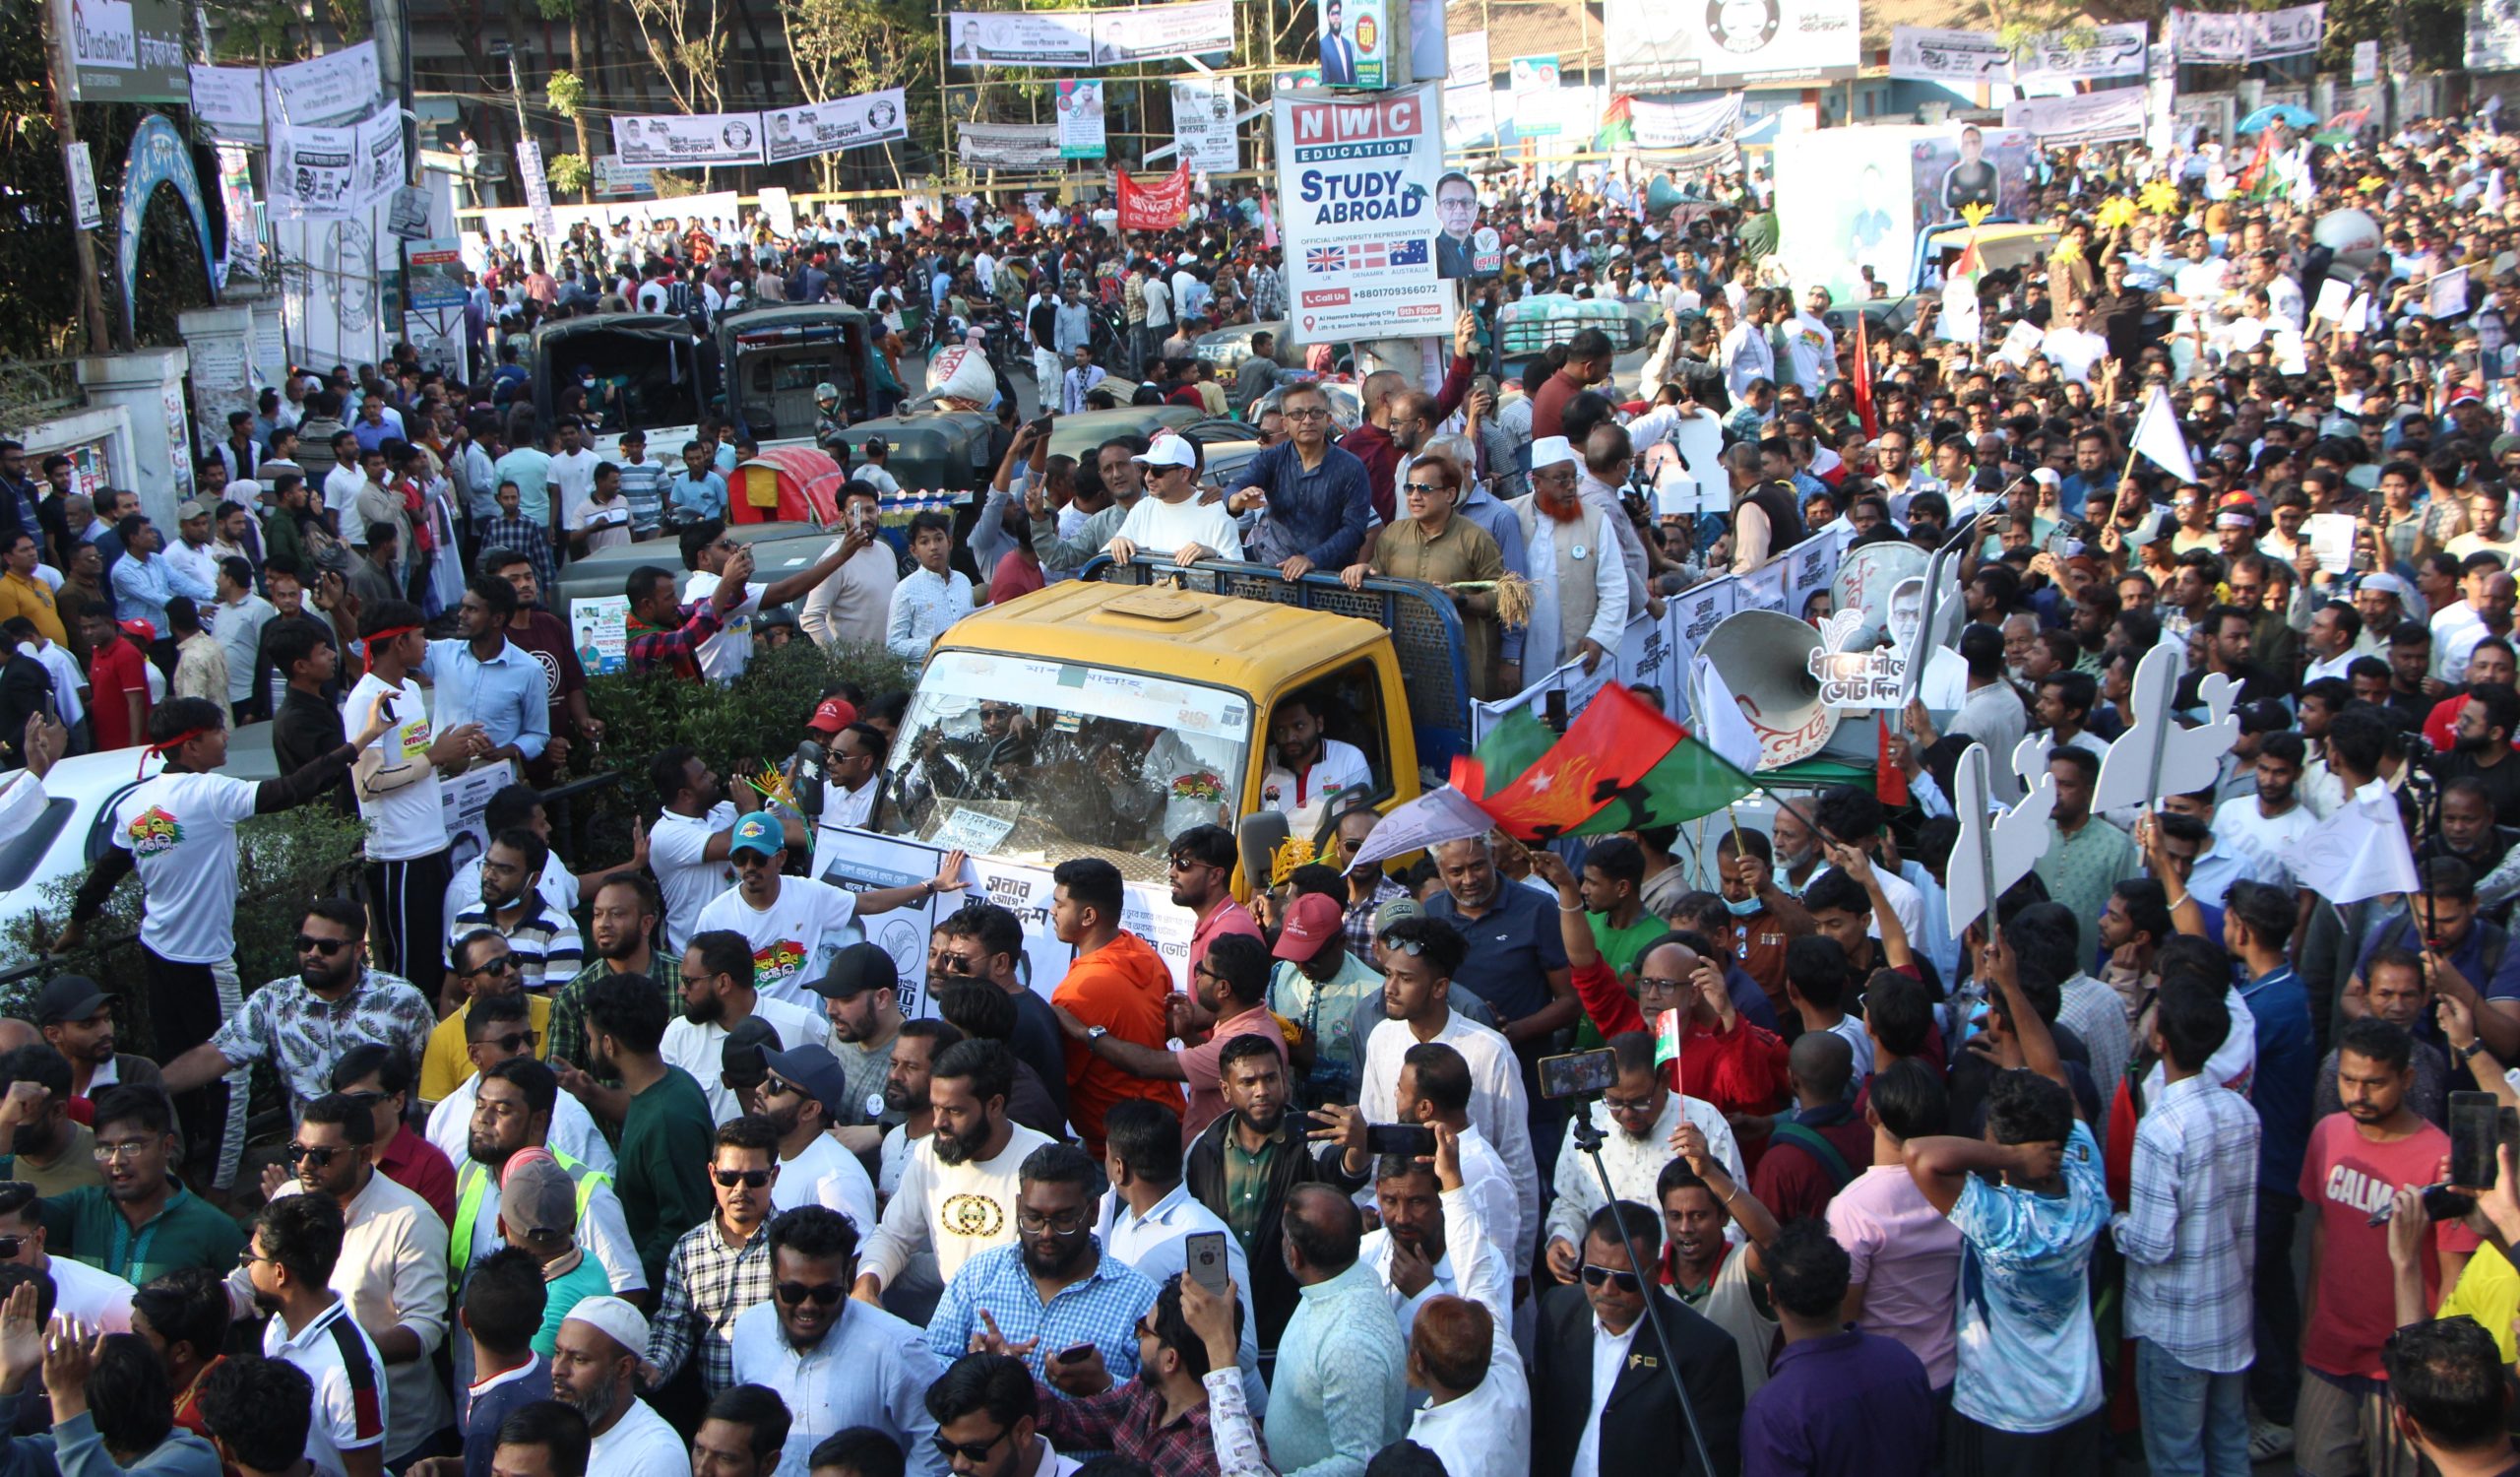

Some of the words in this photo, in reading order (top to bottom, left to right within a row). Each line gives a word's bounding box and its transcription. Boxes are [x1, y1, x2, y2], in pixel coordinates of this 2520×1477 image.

[87, 29, 104, 60] Trust
[103, 31, 121, 61] Bank
[1300, 101, 1412, 139] NWC
[1300, 142, 1410, 161] EDUCATION
[1300, 169, 1404, 203] STUDY
[1315, 191, 1422, 225] ABROAD
[1300, 236, 1331, 245] OFFICIAL
[1332, 233, 1372, 243] UNIVERSITY
[1373, 228, 1431, 239] REPRESENTATIVE
[1391, 266, 1428, 276] AUSTRALIA
[1315, 293, 1333, 303] Call
[1334, 291, 1346, 301] Us
[1354, 285, 1438, 298] +8801709366072
[1350, 310, 1381, 319] Shopping
[1416, 305, 1439, 314] Floor
[1822, 678, 1868, 704] ভোট
[1871, 676, 1901, 701] দিন
[986, 875, 1032, 899] সবার
[992, 894, 1019, 907] আগে
[963, 893, 1049, 928] বাদেশ
[1140, 912, 1155, 921] যাবে
[1386, 905, 1413, 916] GUCCI
[1162, 941, 1189, 958] ভোট
[2326, 1164, 2395, 1214] CALM
